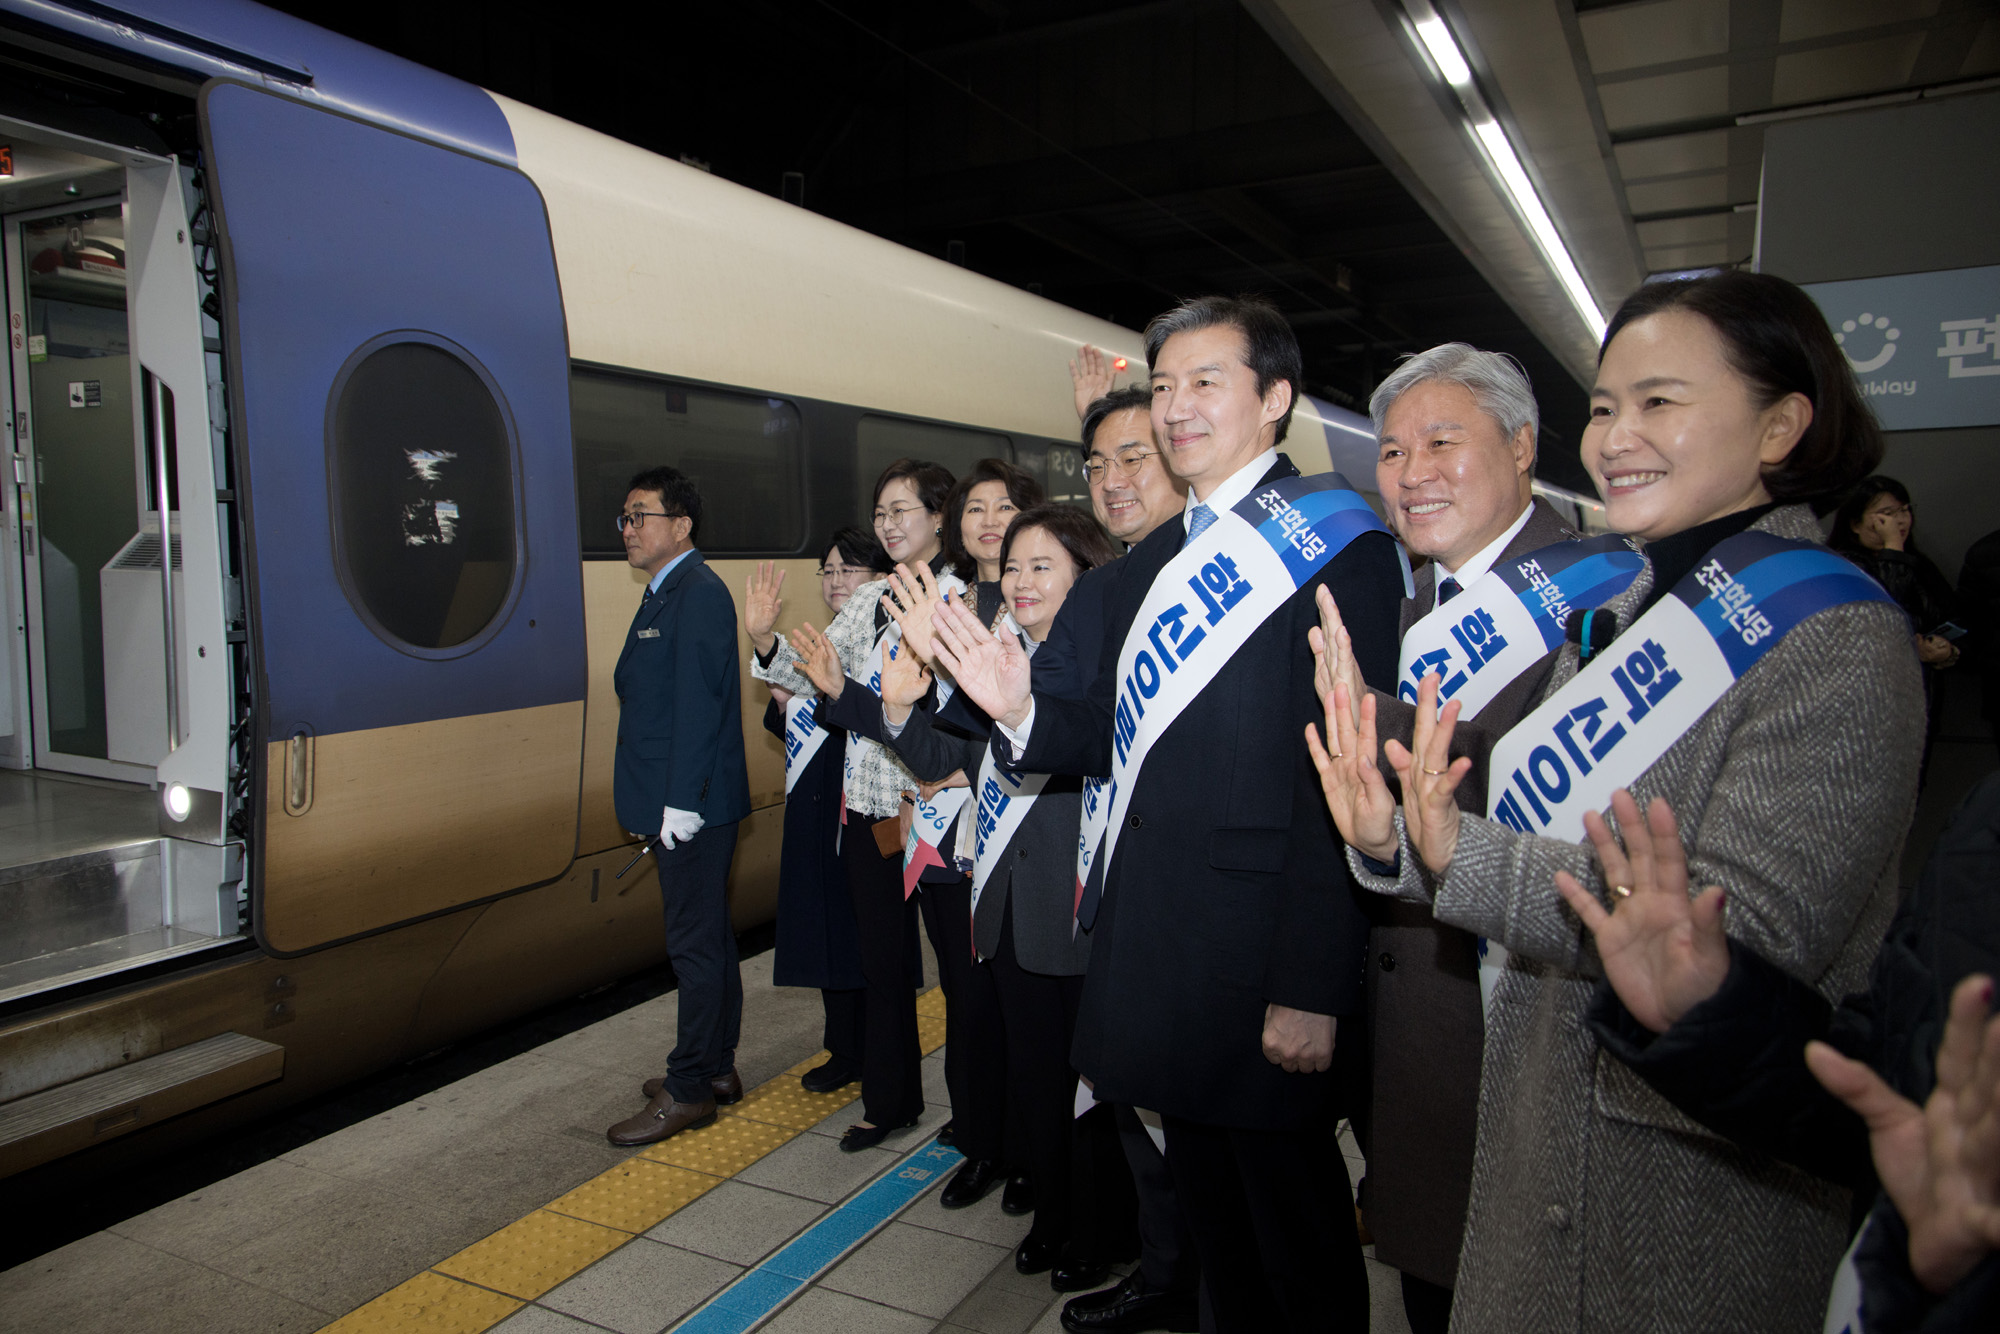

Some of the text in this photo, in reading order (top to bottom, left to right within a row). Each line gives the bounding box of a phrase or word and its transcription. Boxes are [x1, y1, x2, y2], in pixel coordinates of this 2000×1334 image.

[1861, 380, 1916, 397] yWay
[1255, 489, 1327, 561] 조국혁신당
[1694, 558, 1775, 646] 조국혁신당
[1114, 552, 1253, 768] 혁신으로
[1399, 606, 1509, 709] 혁신
